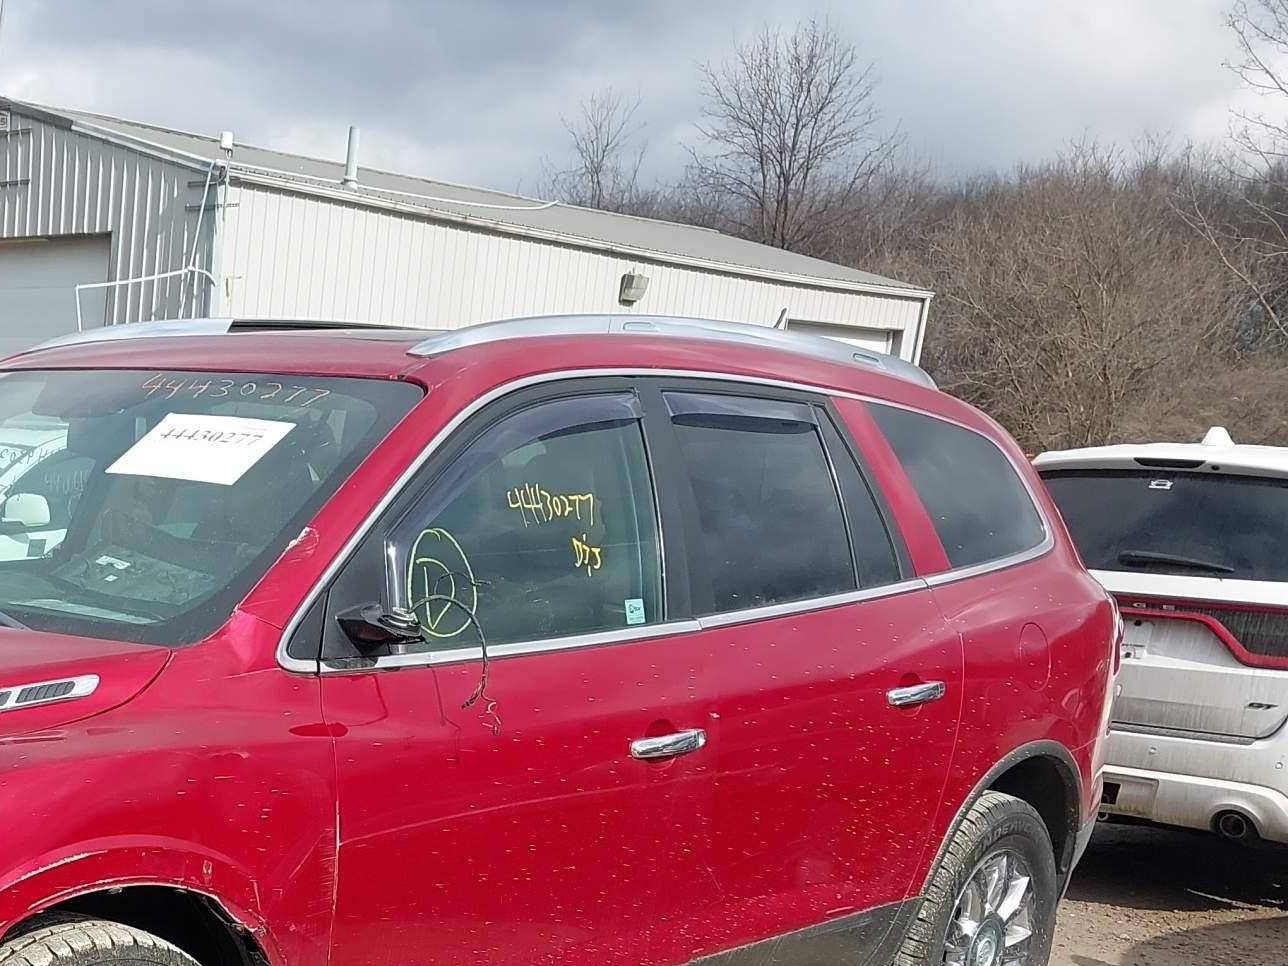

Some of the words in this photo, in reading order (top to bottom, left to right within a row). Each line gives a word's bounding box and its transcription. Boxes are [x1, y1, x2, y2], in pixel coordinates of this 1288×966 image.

[141, 372, 331, 408] 44430277
[160, 427, 265, 446] 44430277
[506, 482, 594, 528] 44430277
